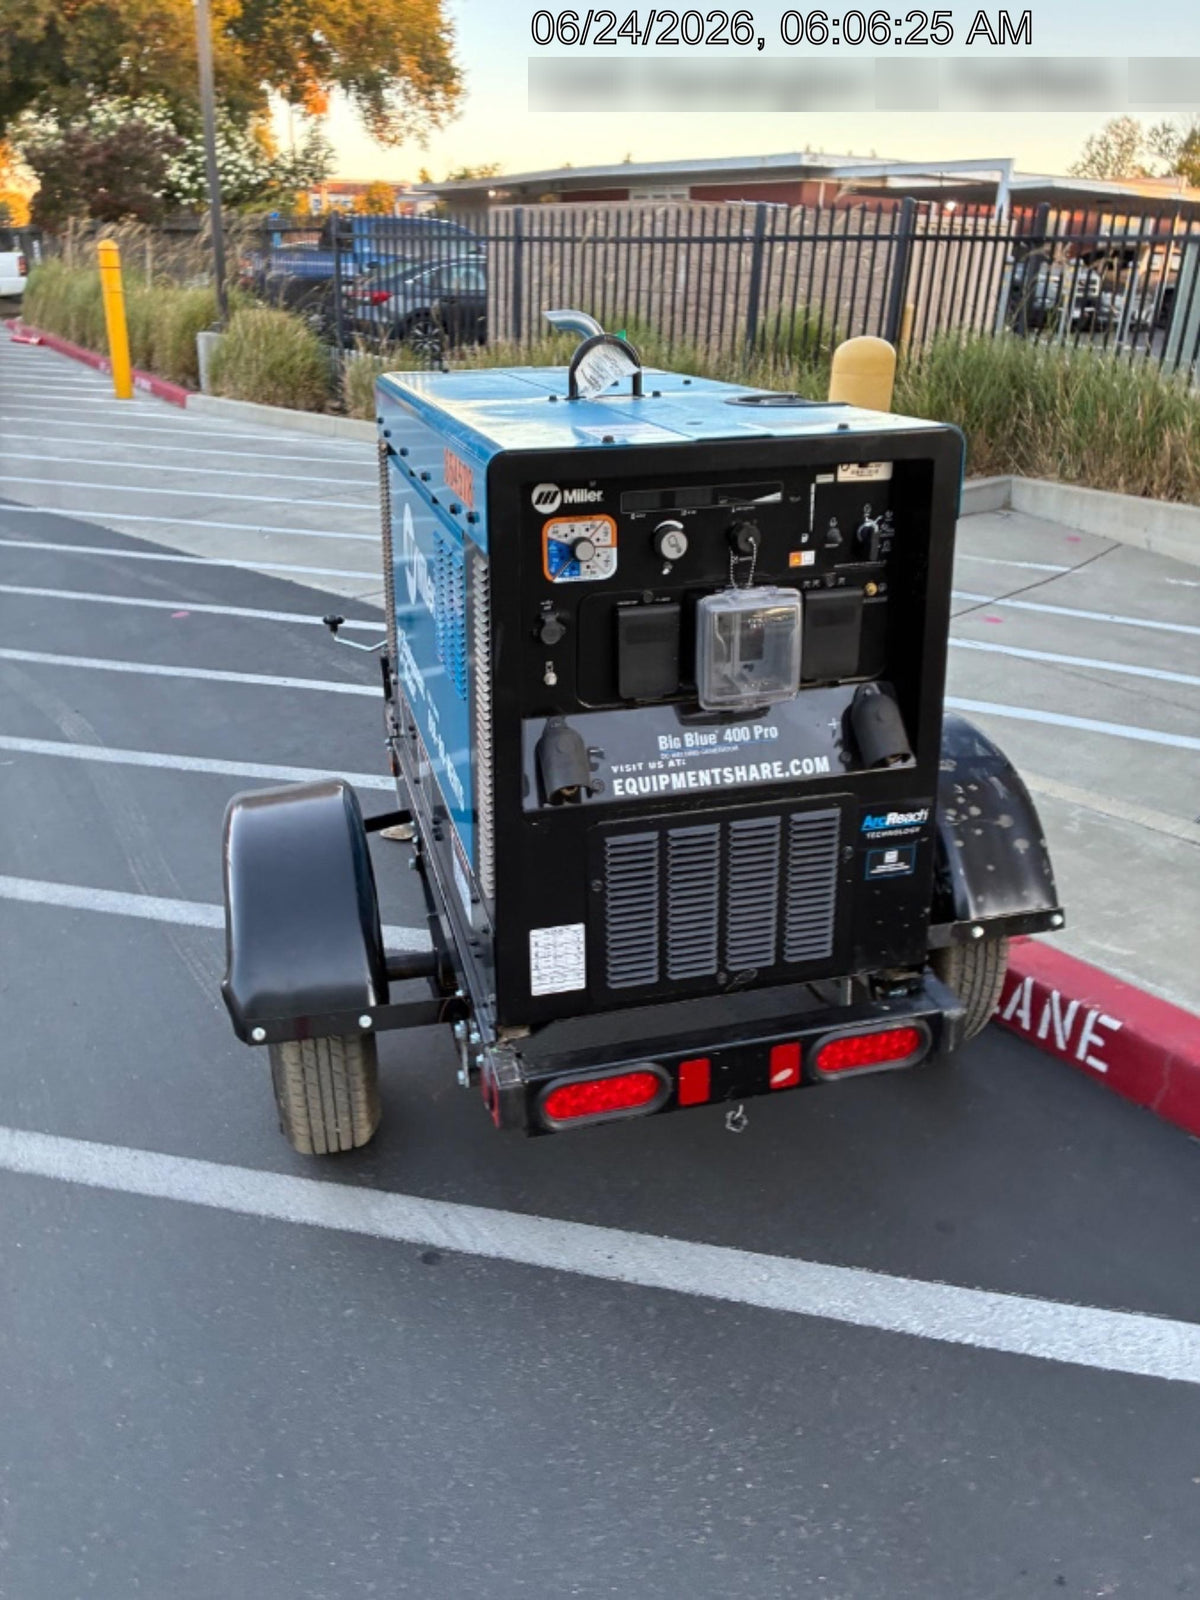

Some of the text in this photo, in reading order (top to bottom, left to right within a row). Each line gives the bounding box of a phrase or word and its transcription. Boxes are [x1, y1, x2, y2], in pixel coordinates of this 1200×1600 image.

[563, 488, 604, 504] Miller
[658, 725, 778, 750] Big Blue 400 Pro
[611, 758, 686, 773] VISIT US AT:
[612, 756, 831, 796] EQUIPMENTSHARE.COM
[995, 976, 1124, 1073] ANE
